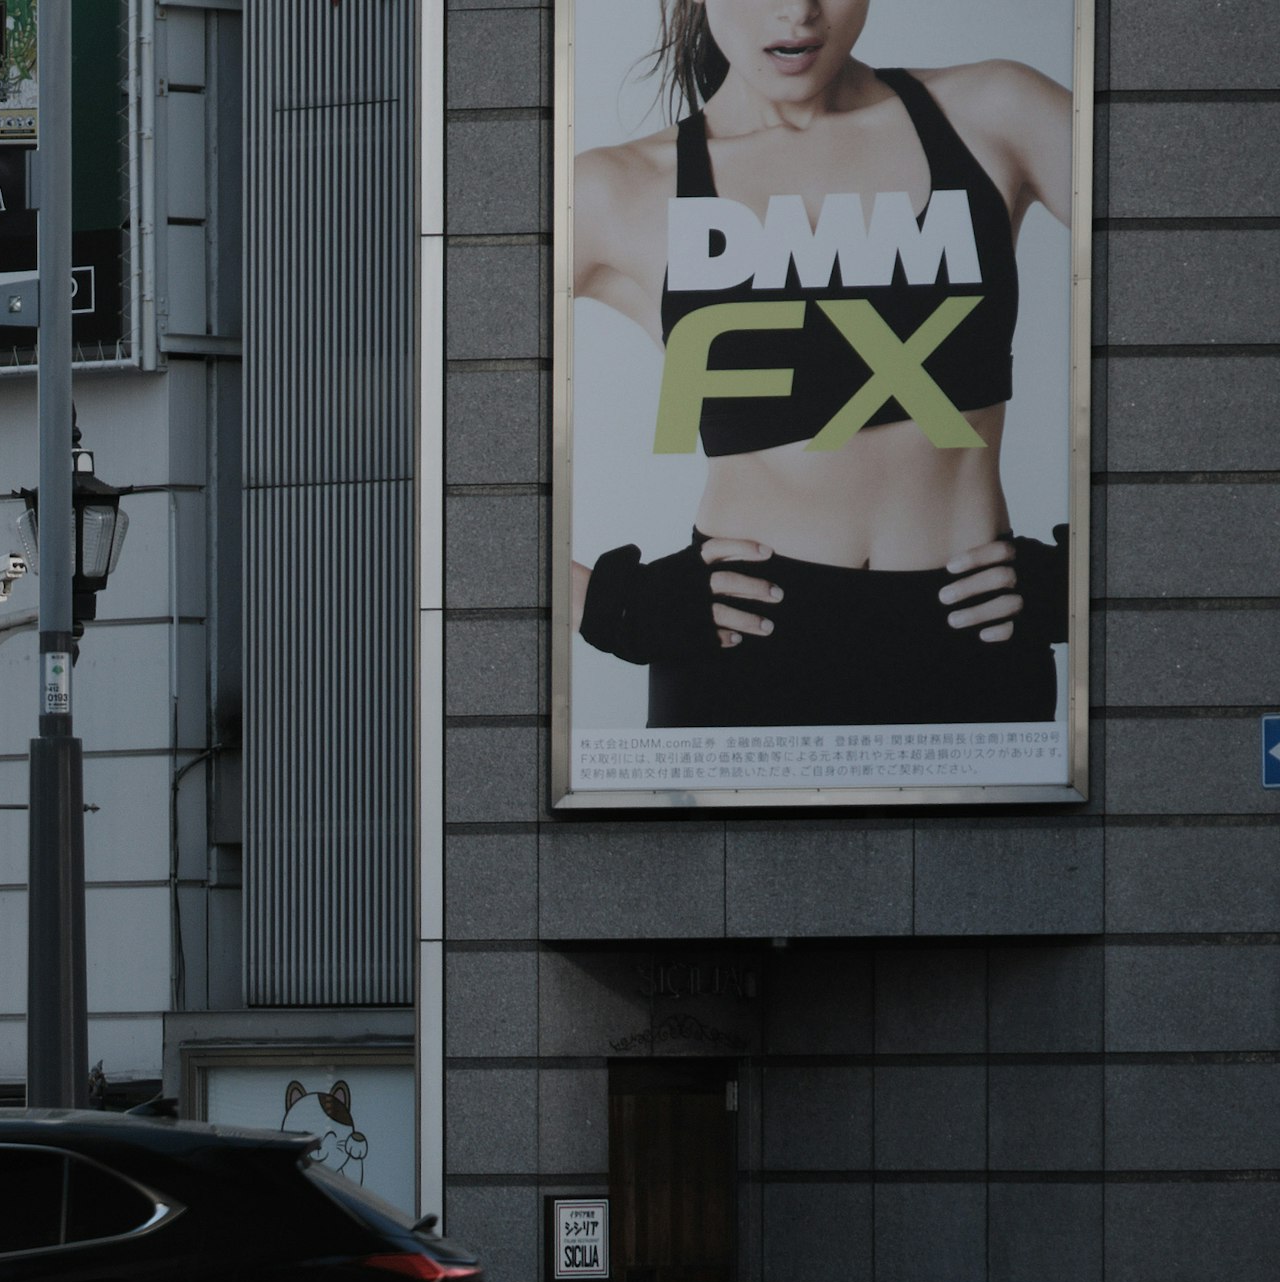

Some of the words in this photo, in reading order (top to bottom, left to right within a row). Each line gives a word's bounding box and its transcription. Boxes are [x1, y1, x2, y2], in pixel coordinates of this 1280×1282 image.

[667, 189, 983, 292] DMM
[651, 294, 989, 455] FX
[564, 1221, 599, 1237] シシリア
[564, 1245, 600, 1269] SICILIA
